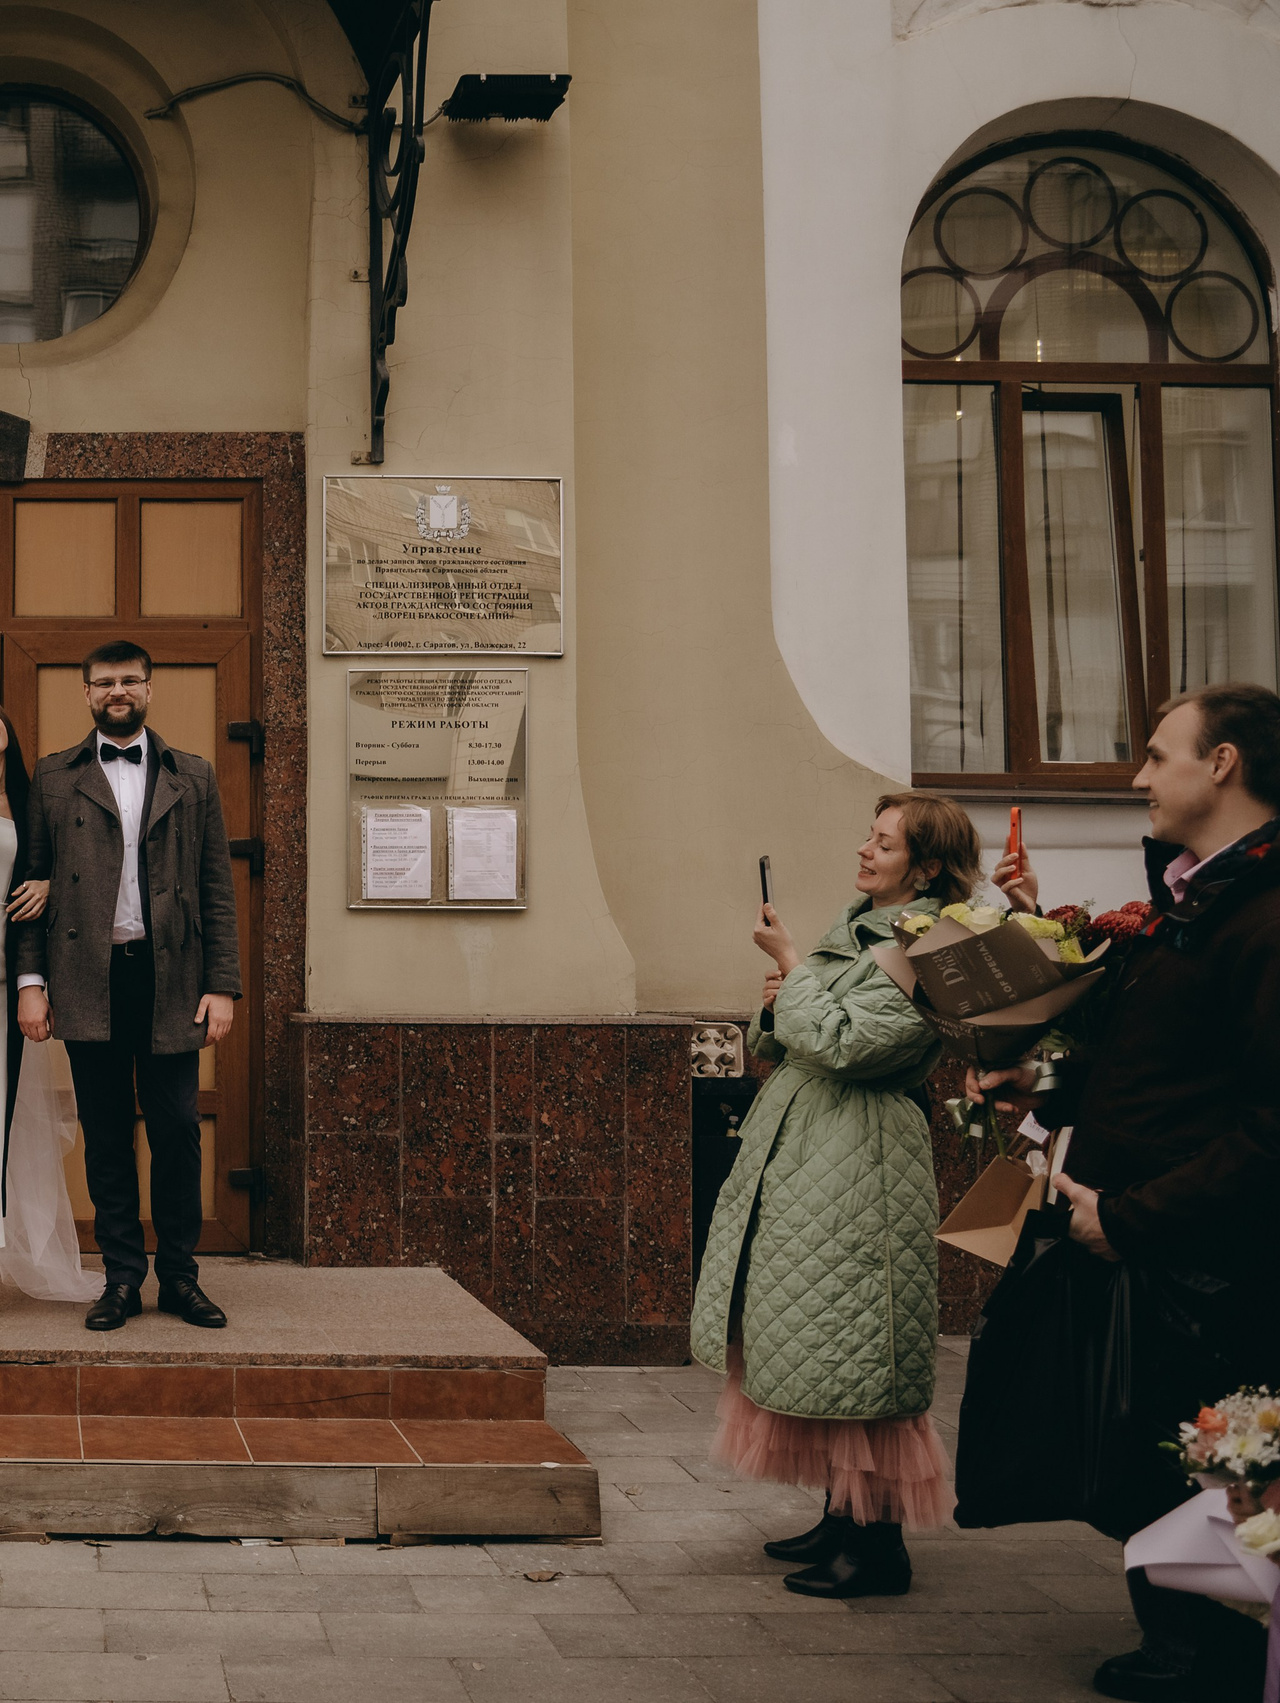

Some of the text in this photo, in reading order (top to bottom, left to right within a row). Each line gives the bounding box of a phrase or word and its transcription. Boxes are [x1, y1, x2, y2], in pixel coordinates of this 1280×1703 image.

[402, 544, 482, 555] Управление
[365, 581, 521, 591] СПЕЦИАЛИЗИРОВАННЫЙ ОТДЕЛ
[359, 591, 529, 600] ГОСУДАРСТВЕННОЙ РЕГИСТРАЦИИ
[472, 602, 533, 610] СОСТОЯНИЯ
[372, 611, 514, 620] «ДВОРЕЦ БРАКОСОЧЕТАНИЙ»
[357, 641, 382, 649] Адрес:
[385, 641, 414, 649] 410002,
[423, 641, 458, 649] Саратов,
[474, 641, 516, 649] Волжская,
[518, 641, 526, 649] 22
[391, 721, 489, 729] РЕЖИМ РАБОТЫ
[976, 940, 1004, 979] SPECIAL
[1000, 981, 1012, 993] OF
